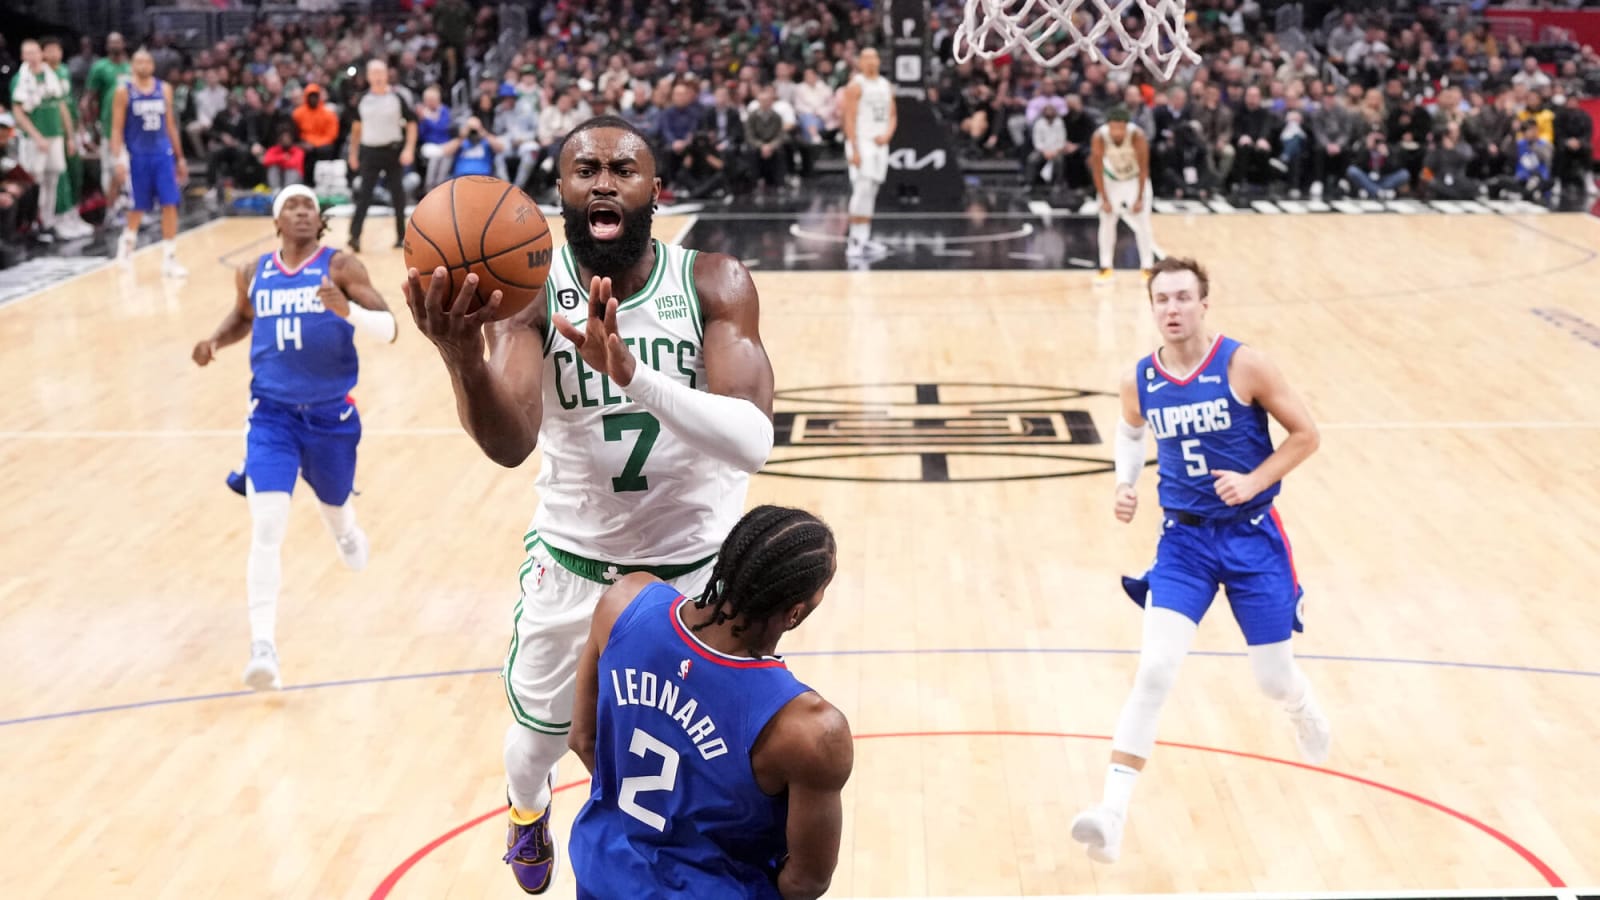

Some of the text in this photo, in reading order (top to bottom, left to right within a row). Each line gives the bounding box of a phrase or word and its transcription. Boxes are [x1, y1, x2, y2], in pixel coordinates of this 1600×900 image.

[256, 286, 326, 318] CLIPPERS
[562, 291, 575, 306] 6
[654, 294, 687, 309] VISTA
[657, 308, 688, 321] PRINT
[276, 317, 303, 351] 14
[1146, 398, 1231, 439] CLIPPERS
[602, 411, 661, 493] 7
[1181, 439, 1208, 477] 5
[611, 668, 728, 761] LEONARD
[617, 727, 680, 832] 2
